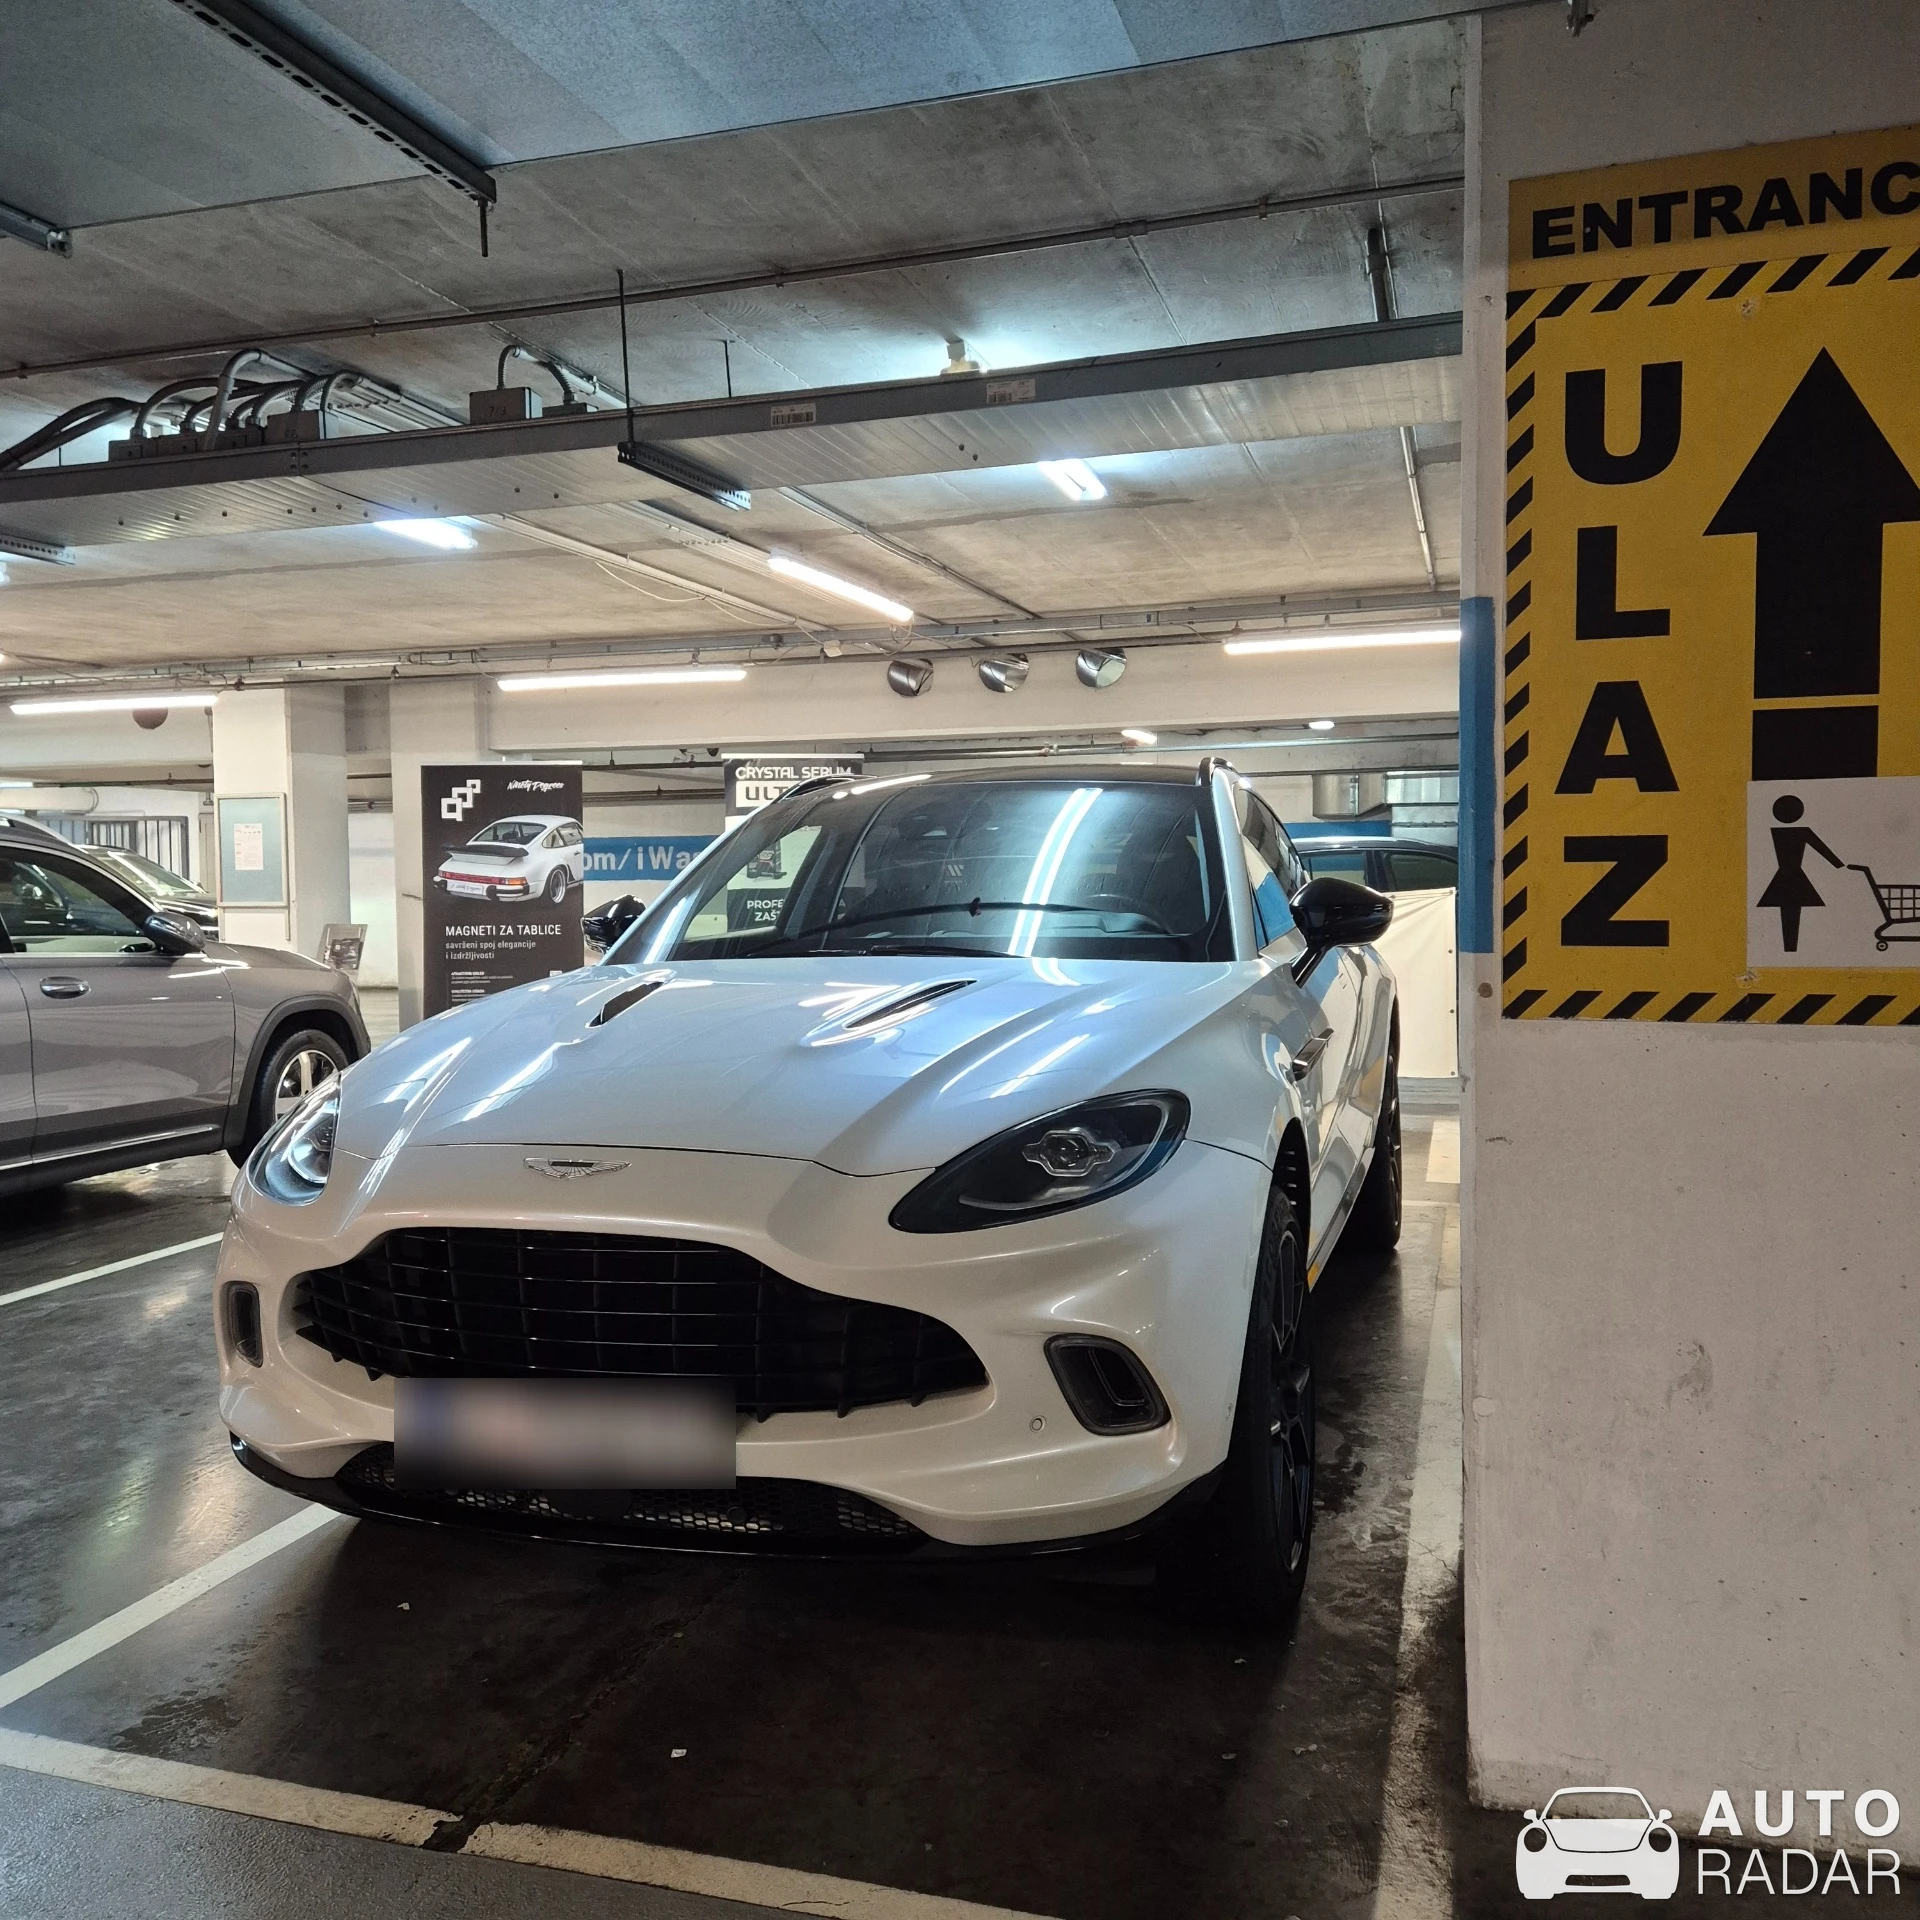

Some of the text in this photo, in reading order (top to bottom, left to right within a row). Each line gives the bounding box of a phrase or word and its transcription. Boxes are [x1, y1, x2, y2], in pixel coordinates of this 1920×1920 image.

[1554, 360, 1684, 948] ULAZ
[735, 766, 799, 779] CRYSTAL
[746, 898, 785, 909] PROFE
[445, 924, 562, 936] MAGNETI ZA TABLICE
[445, 940, 536, 950] savršeni spoj elegancije
[445, 951, 495, 960] i izdržljivosti
